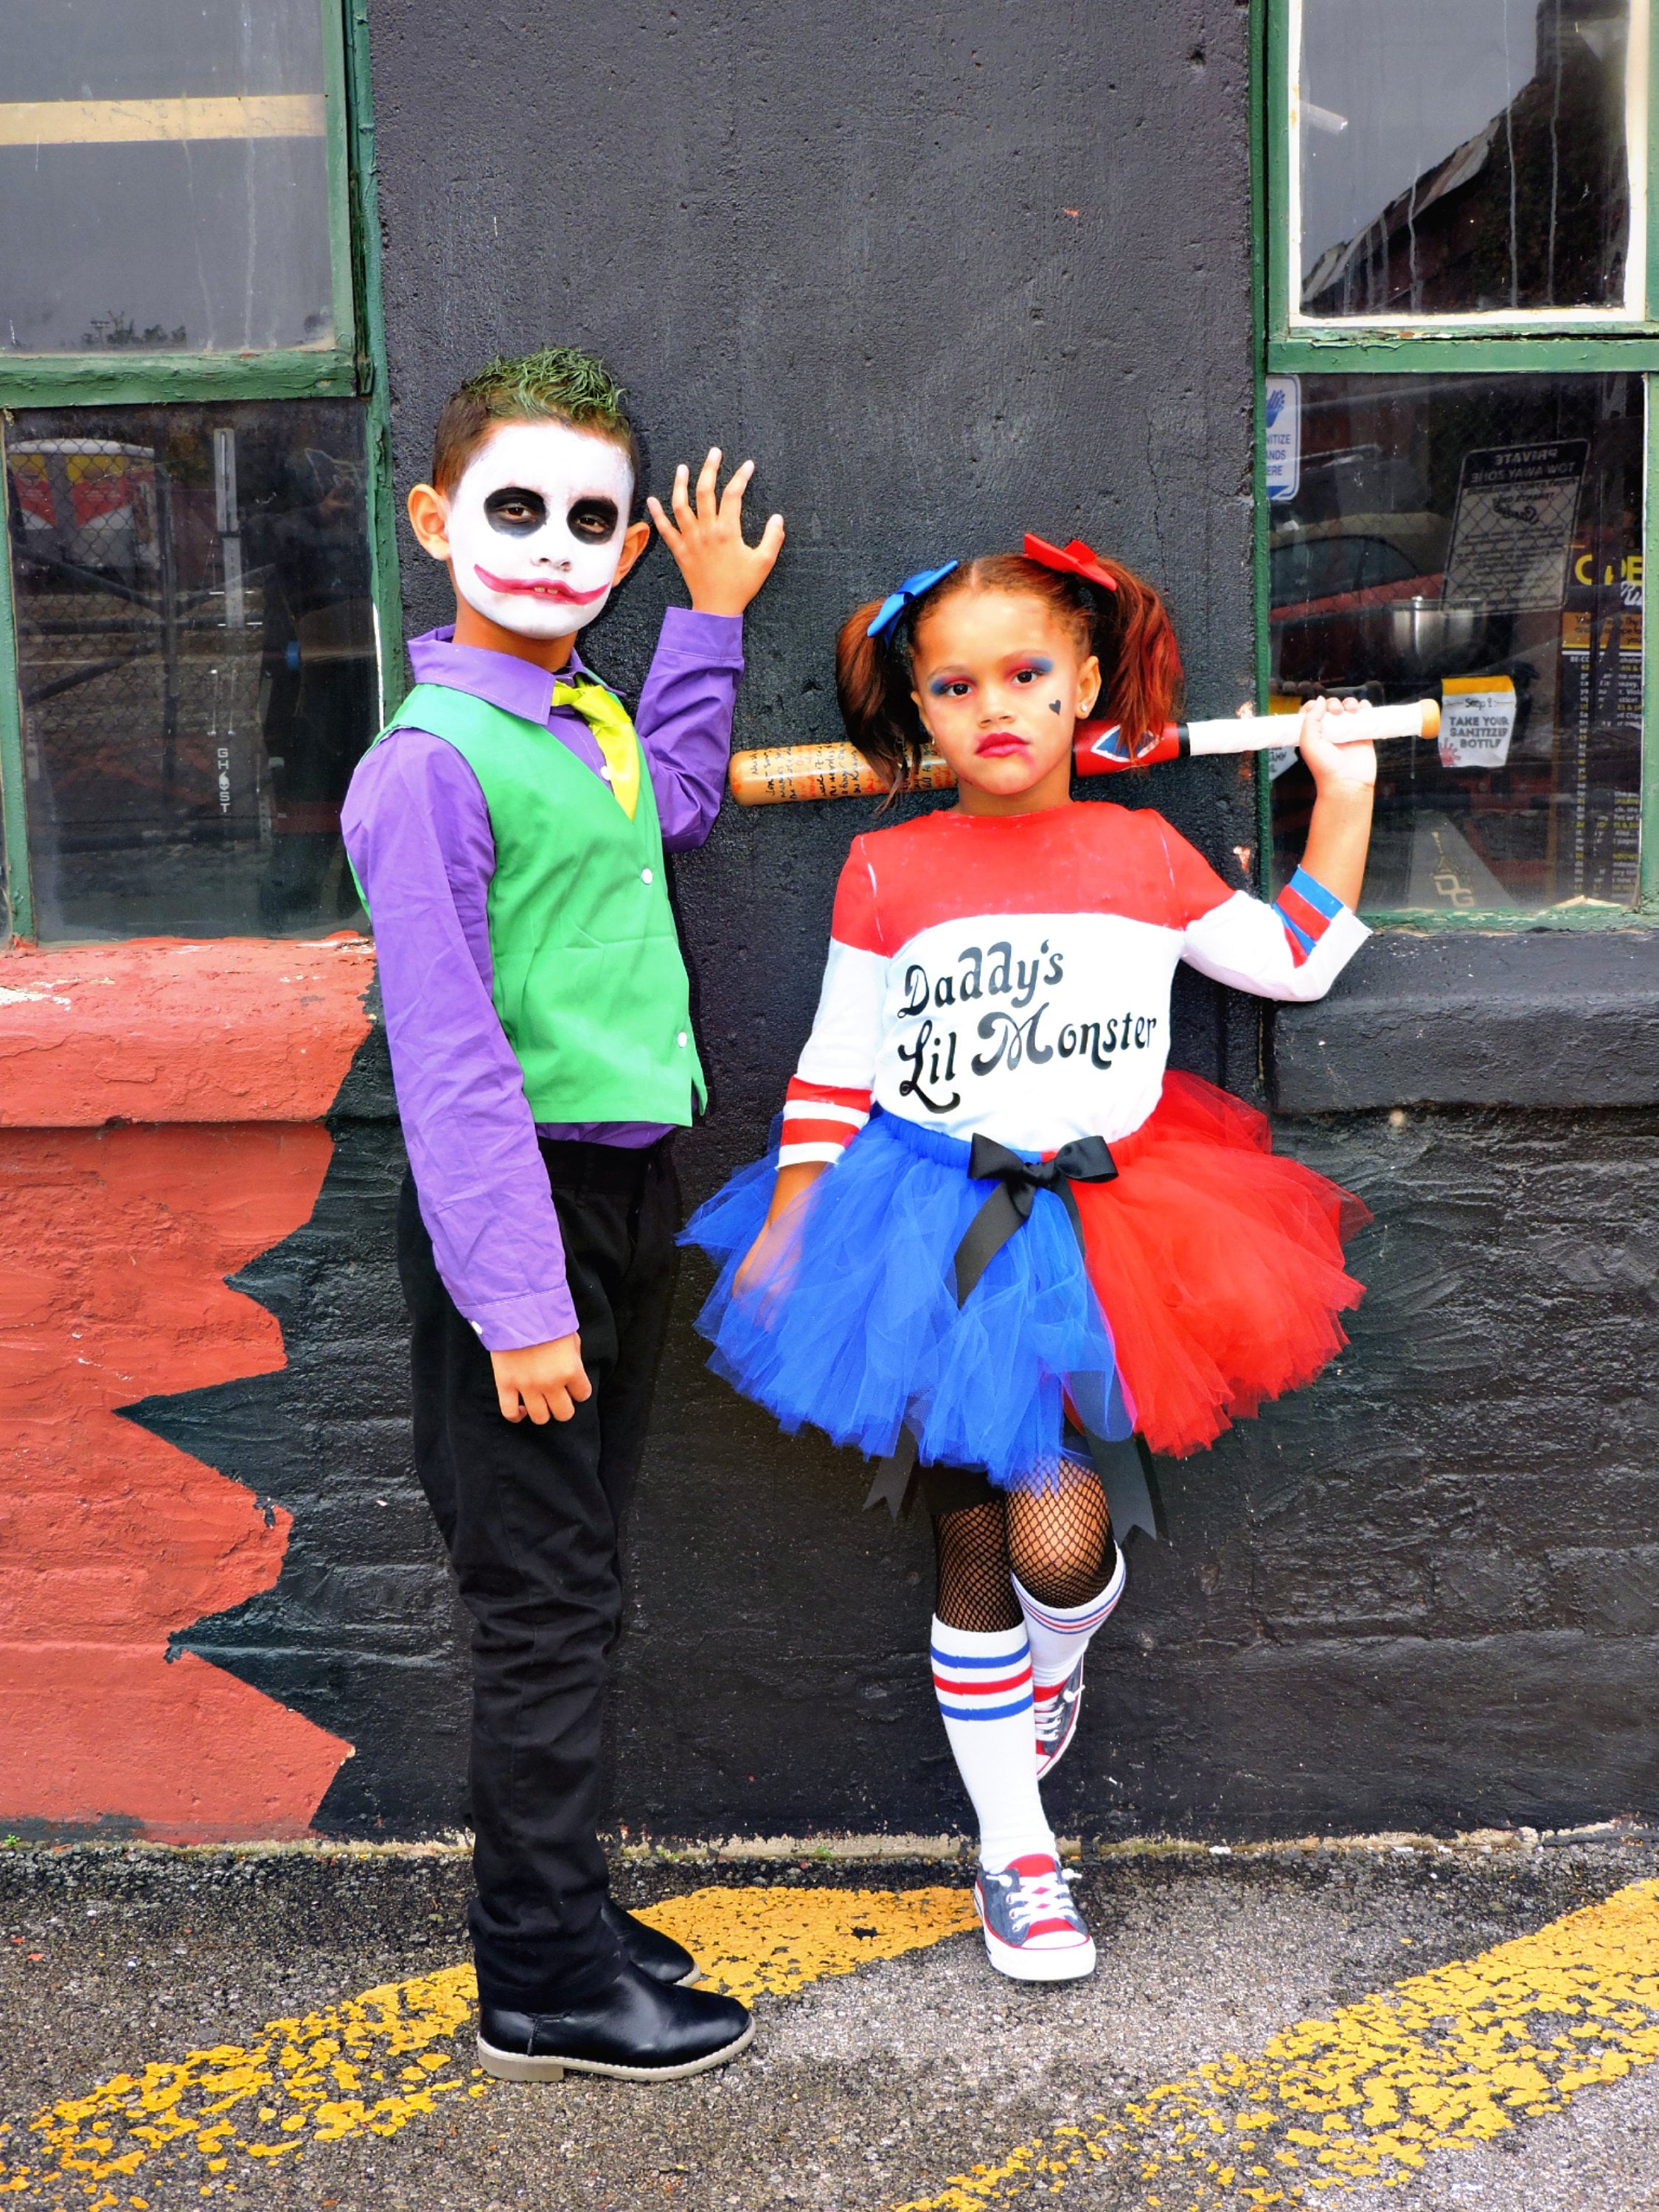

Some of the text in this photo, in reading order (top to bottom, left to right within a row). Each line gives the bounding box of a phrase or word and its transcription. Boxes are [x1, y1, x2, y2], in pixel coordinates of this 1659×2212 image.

[1450, 715, 1509, 726] TAKE YOUR
[897, 939, 1064, 1018] Daddy's
[897, 1002, 1157, 1114] Lil Monster
